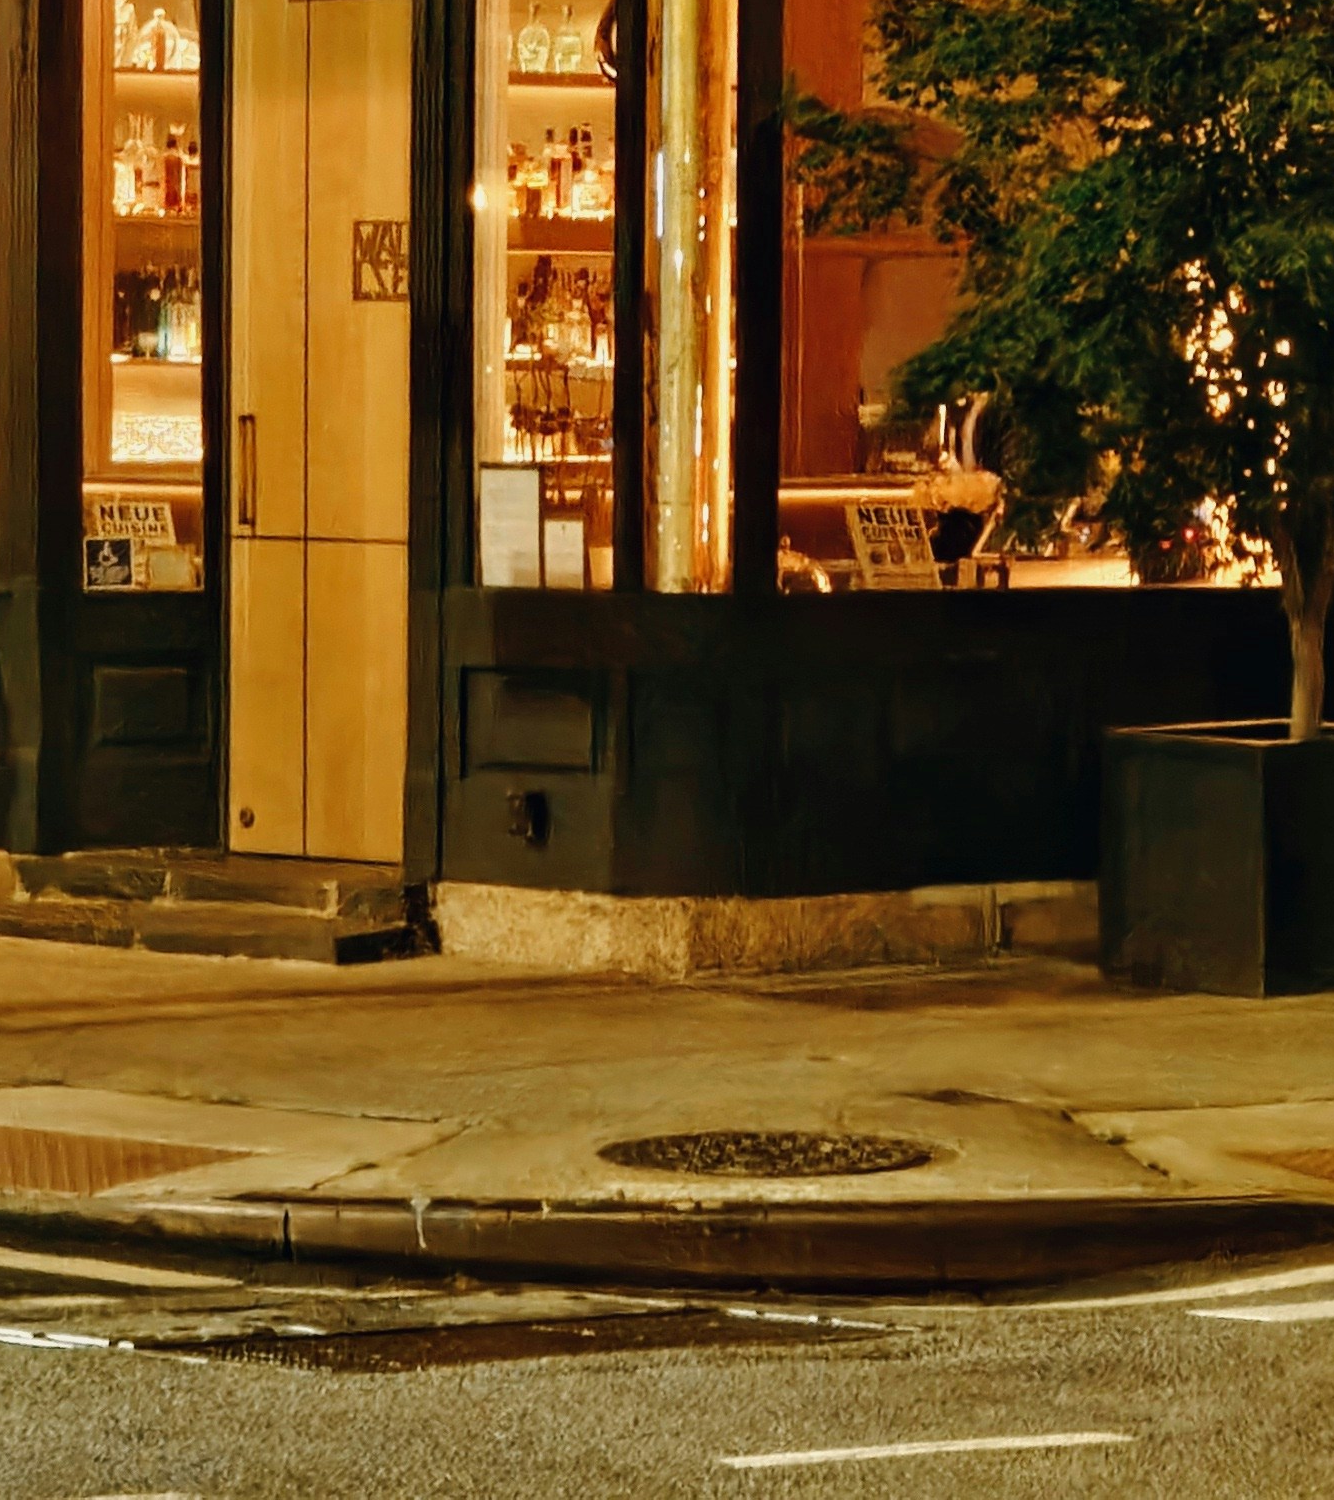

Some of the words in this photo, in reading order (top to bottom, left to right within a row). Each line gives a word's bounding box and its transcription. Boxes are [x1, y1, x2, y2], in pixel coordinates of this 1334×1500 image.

[99, 504, 167, 521] NEUE
[857, 507, 921, 526] NEUE
[100, 521, 169, 536] CUISINE
